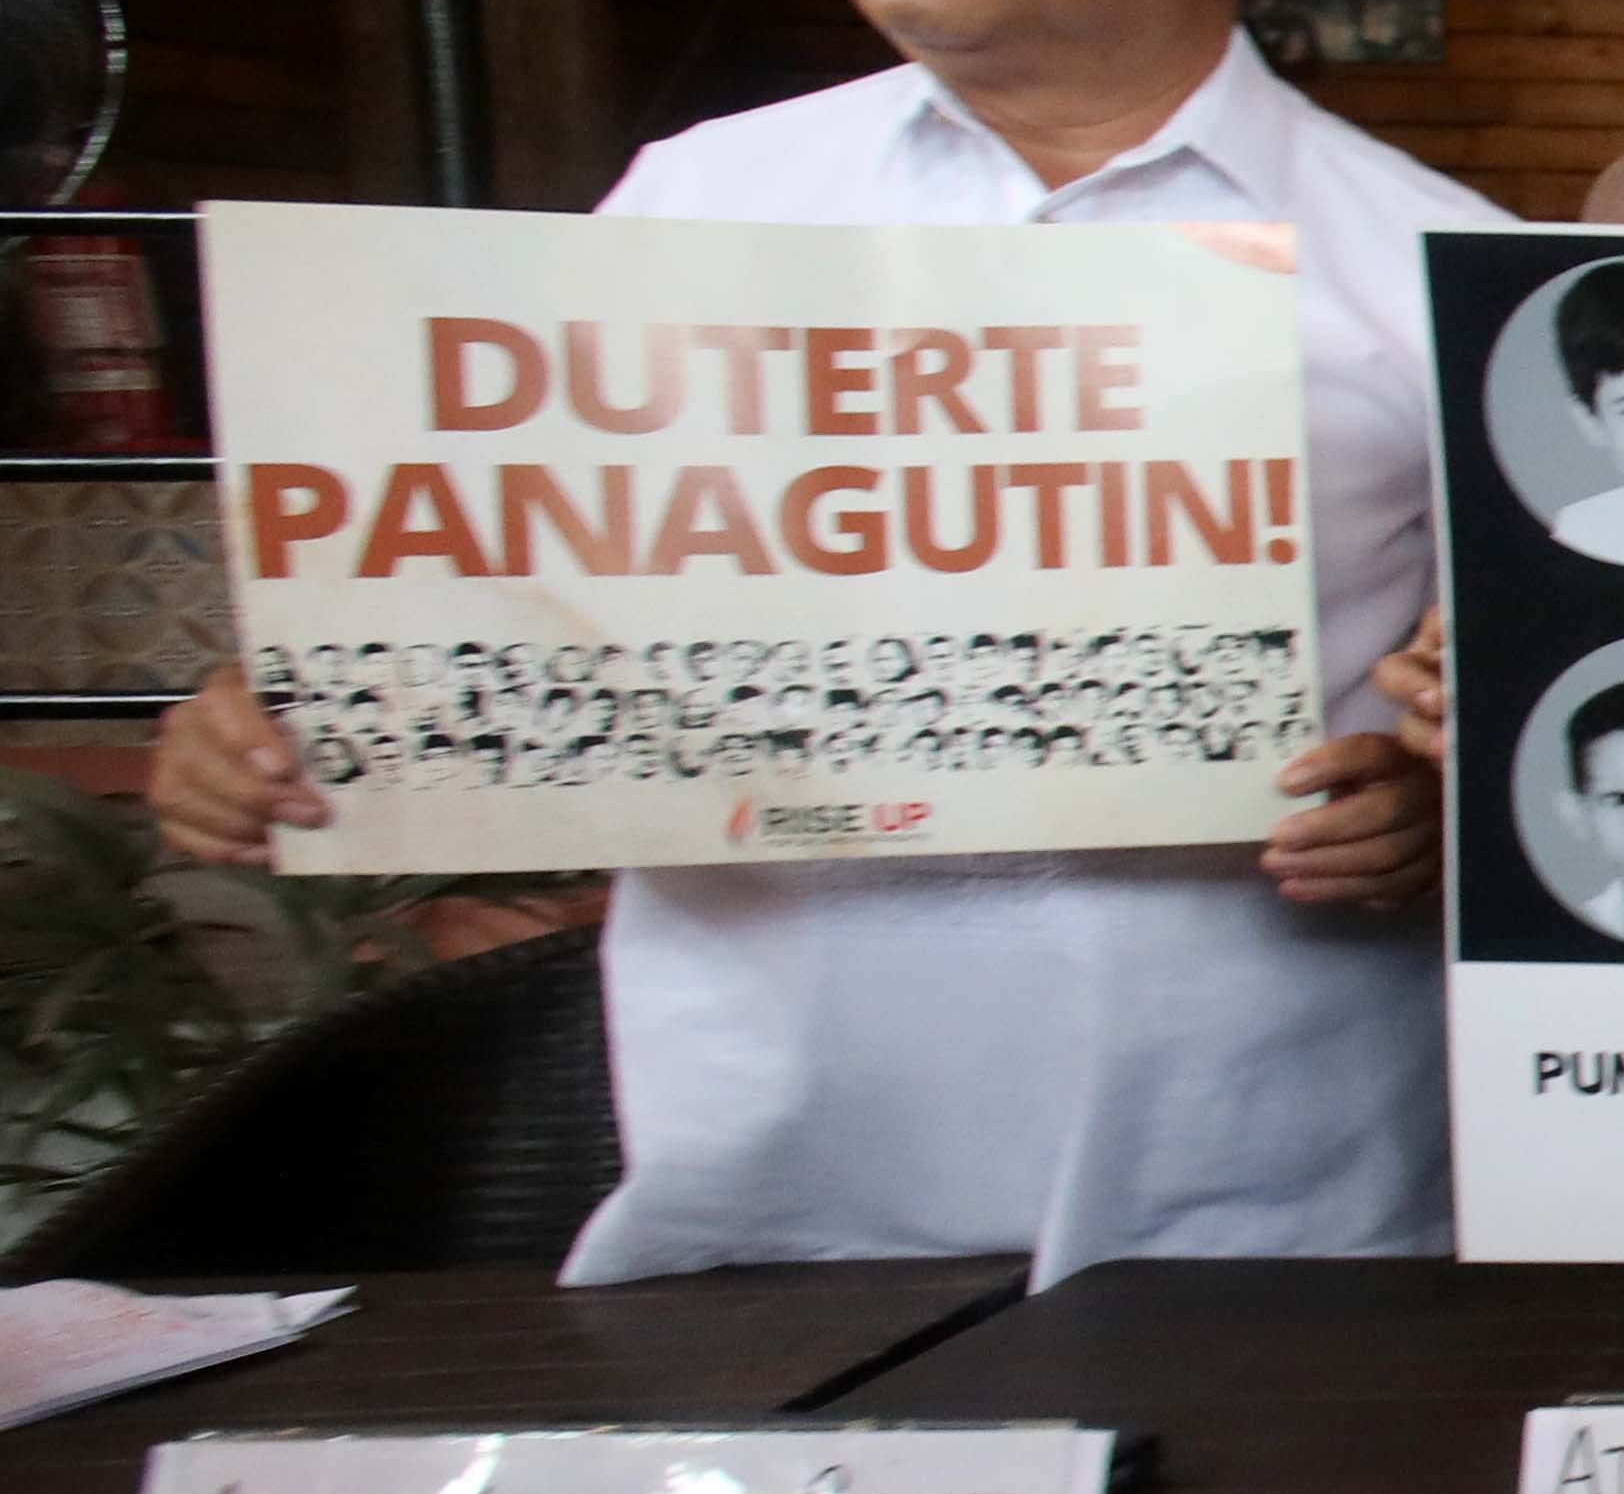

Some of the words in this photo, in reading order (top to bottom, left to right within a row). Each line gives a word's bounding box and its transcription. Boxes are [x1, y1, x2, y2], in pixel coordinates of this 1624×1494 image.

[426, 315, 1144, 437] DUTERTE
[244, 455, 1300, 580] PANAGUTIN!
[871, 801, 934, 833] UP
